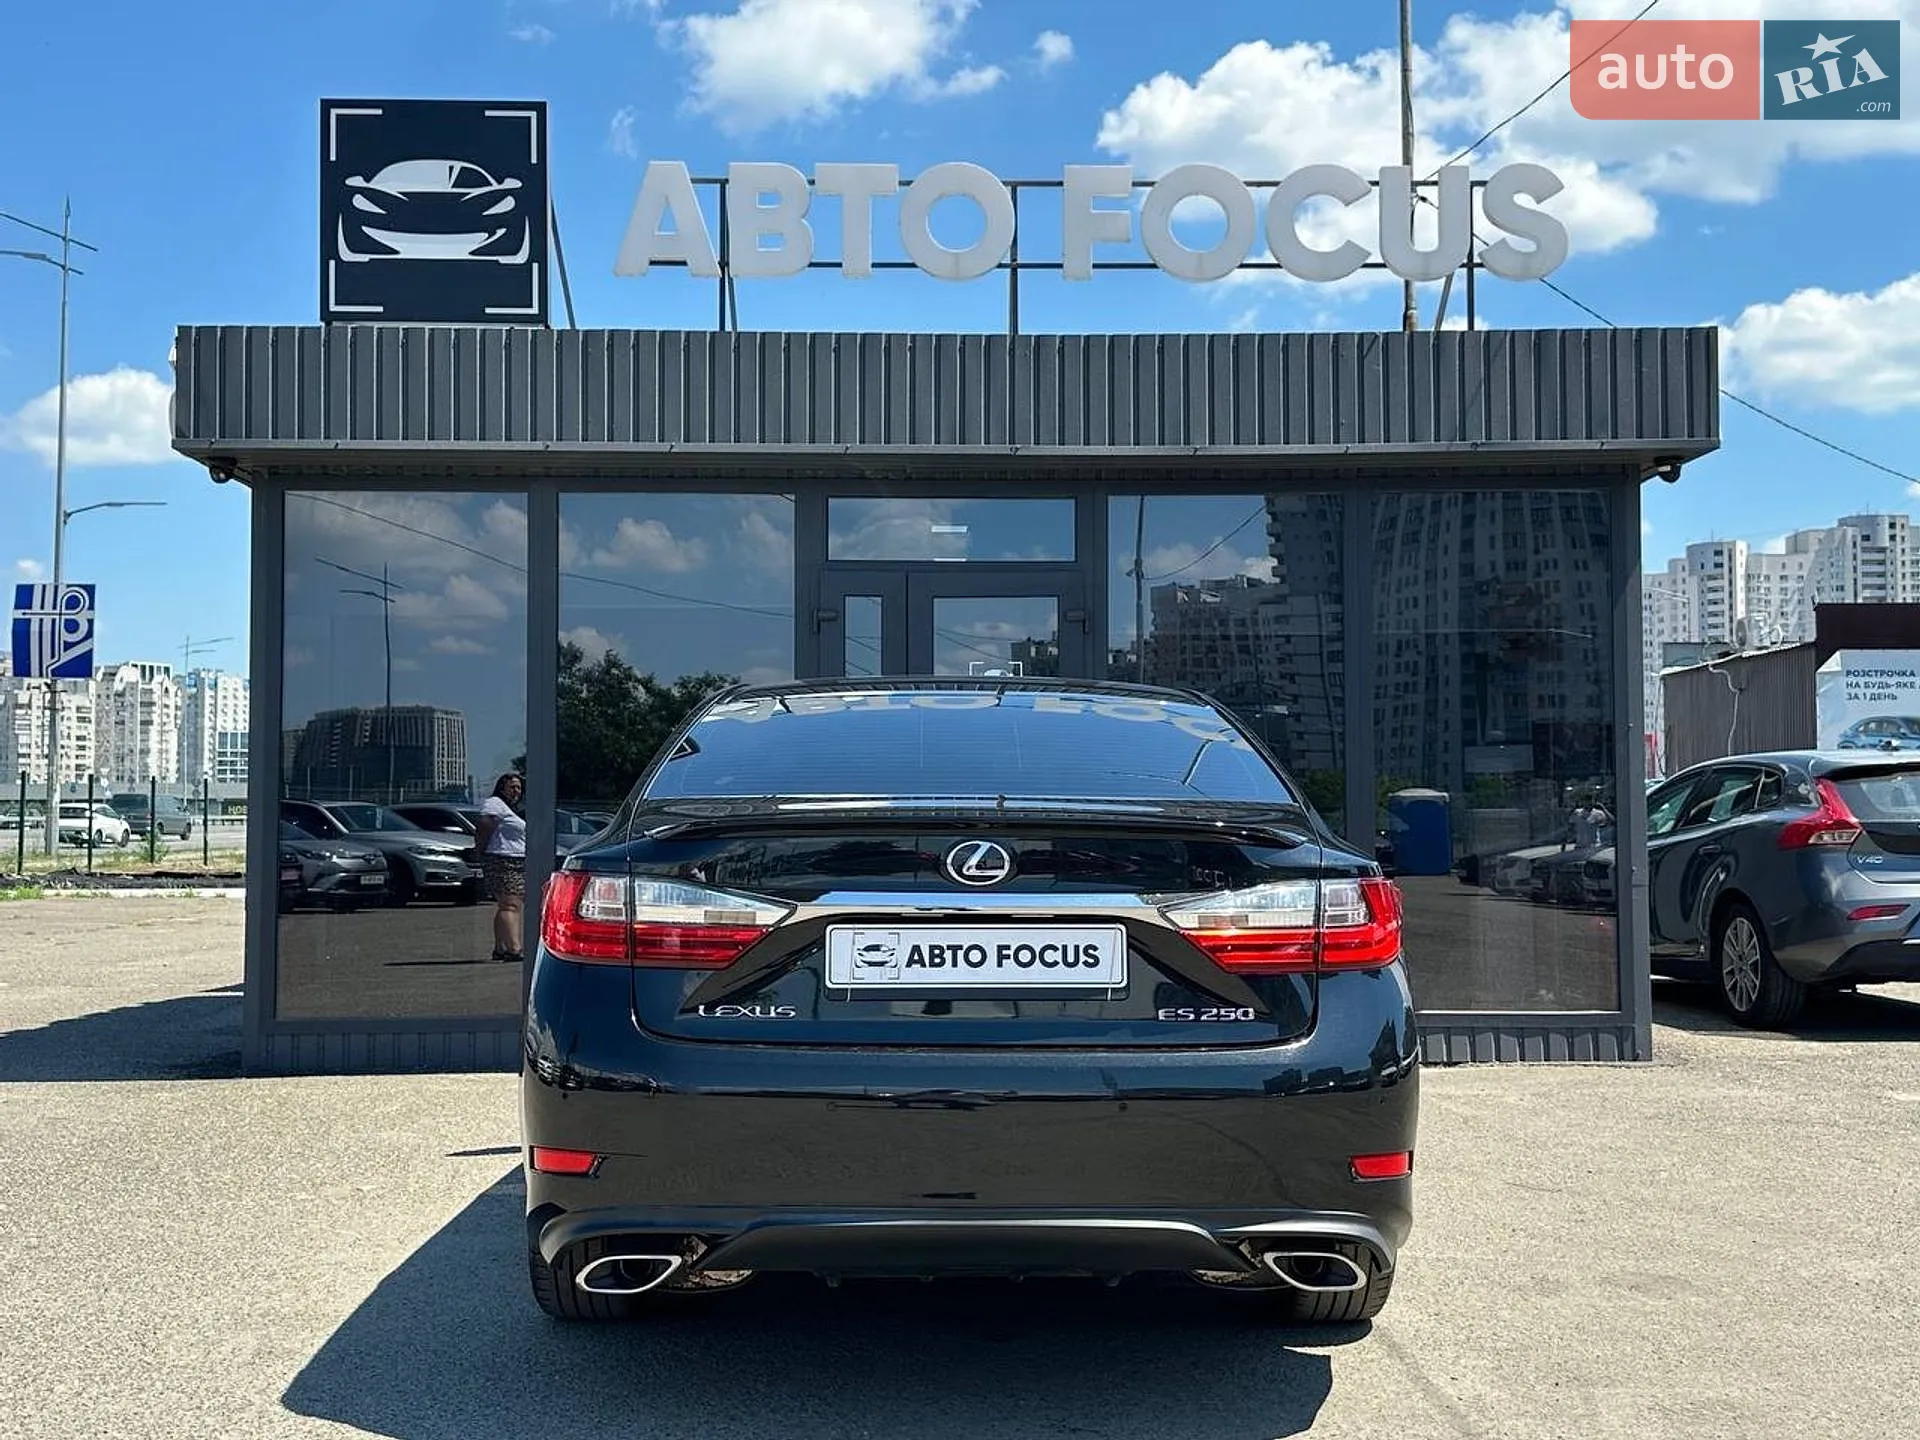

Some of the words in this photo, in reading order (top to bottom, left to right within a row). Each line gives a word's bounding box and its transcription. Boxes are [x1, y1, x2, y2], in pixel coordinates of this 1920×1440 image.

[613, 161, 1015, 281] АВТО
[1062, 162, 1569, 282] FOCUS
[1845, 669, 1916, 678] РОЗСТРОЧКА
[1845, 681, 1861, 689] НА
[1864, 681, 1916, 690] БУДЬ-ЯКЕ
[1846, 692, 1860, 701] ЗА
[1863, 692, 1868, 700] 1
[1869, 692, 1898, 701] ДЕНЬ
[1857, 855, 1884, 864] V40
[905, 943, 988, 969] АВТО
[996, 943, 1100, 969] FOCUS
[698, 1004, 797, 1018] LEXUS
[1158, 1007, 1196, 1021] ES
[1200, 1007, 1255, 1021] 250
